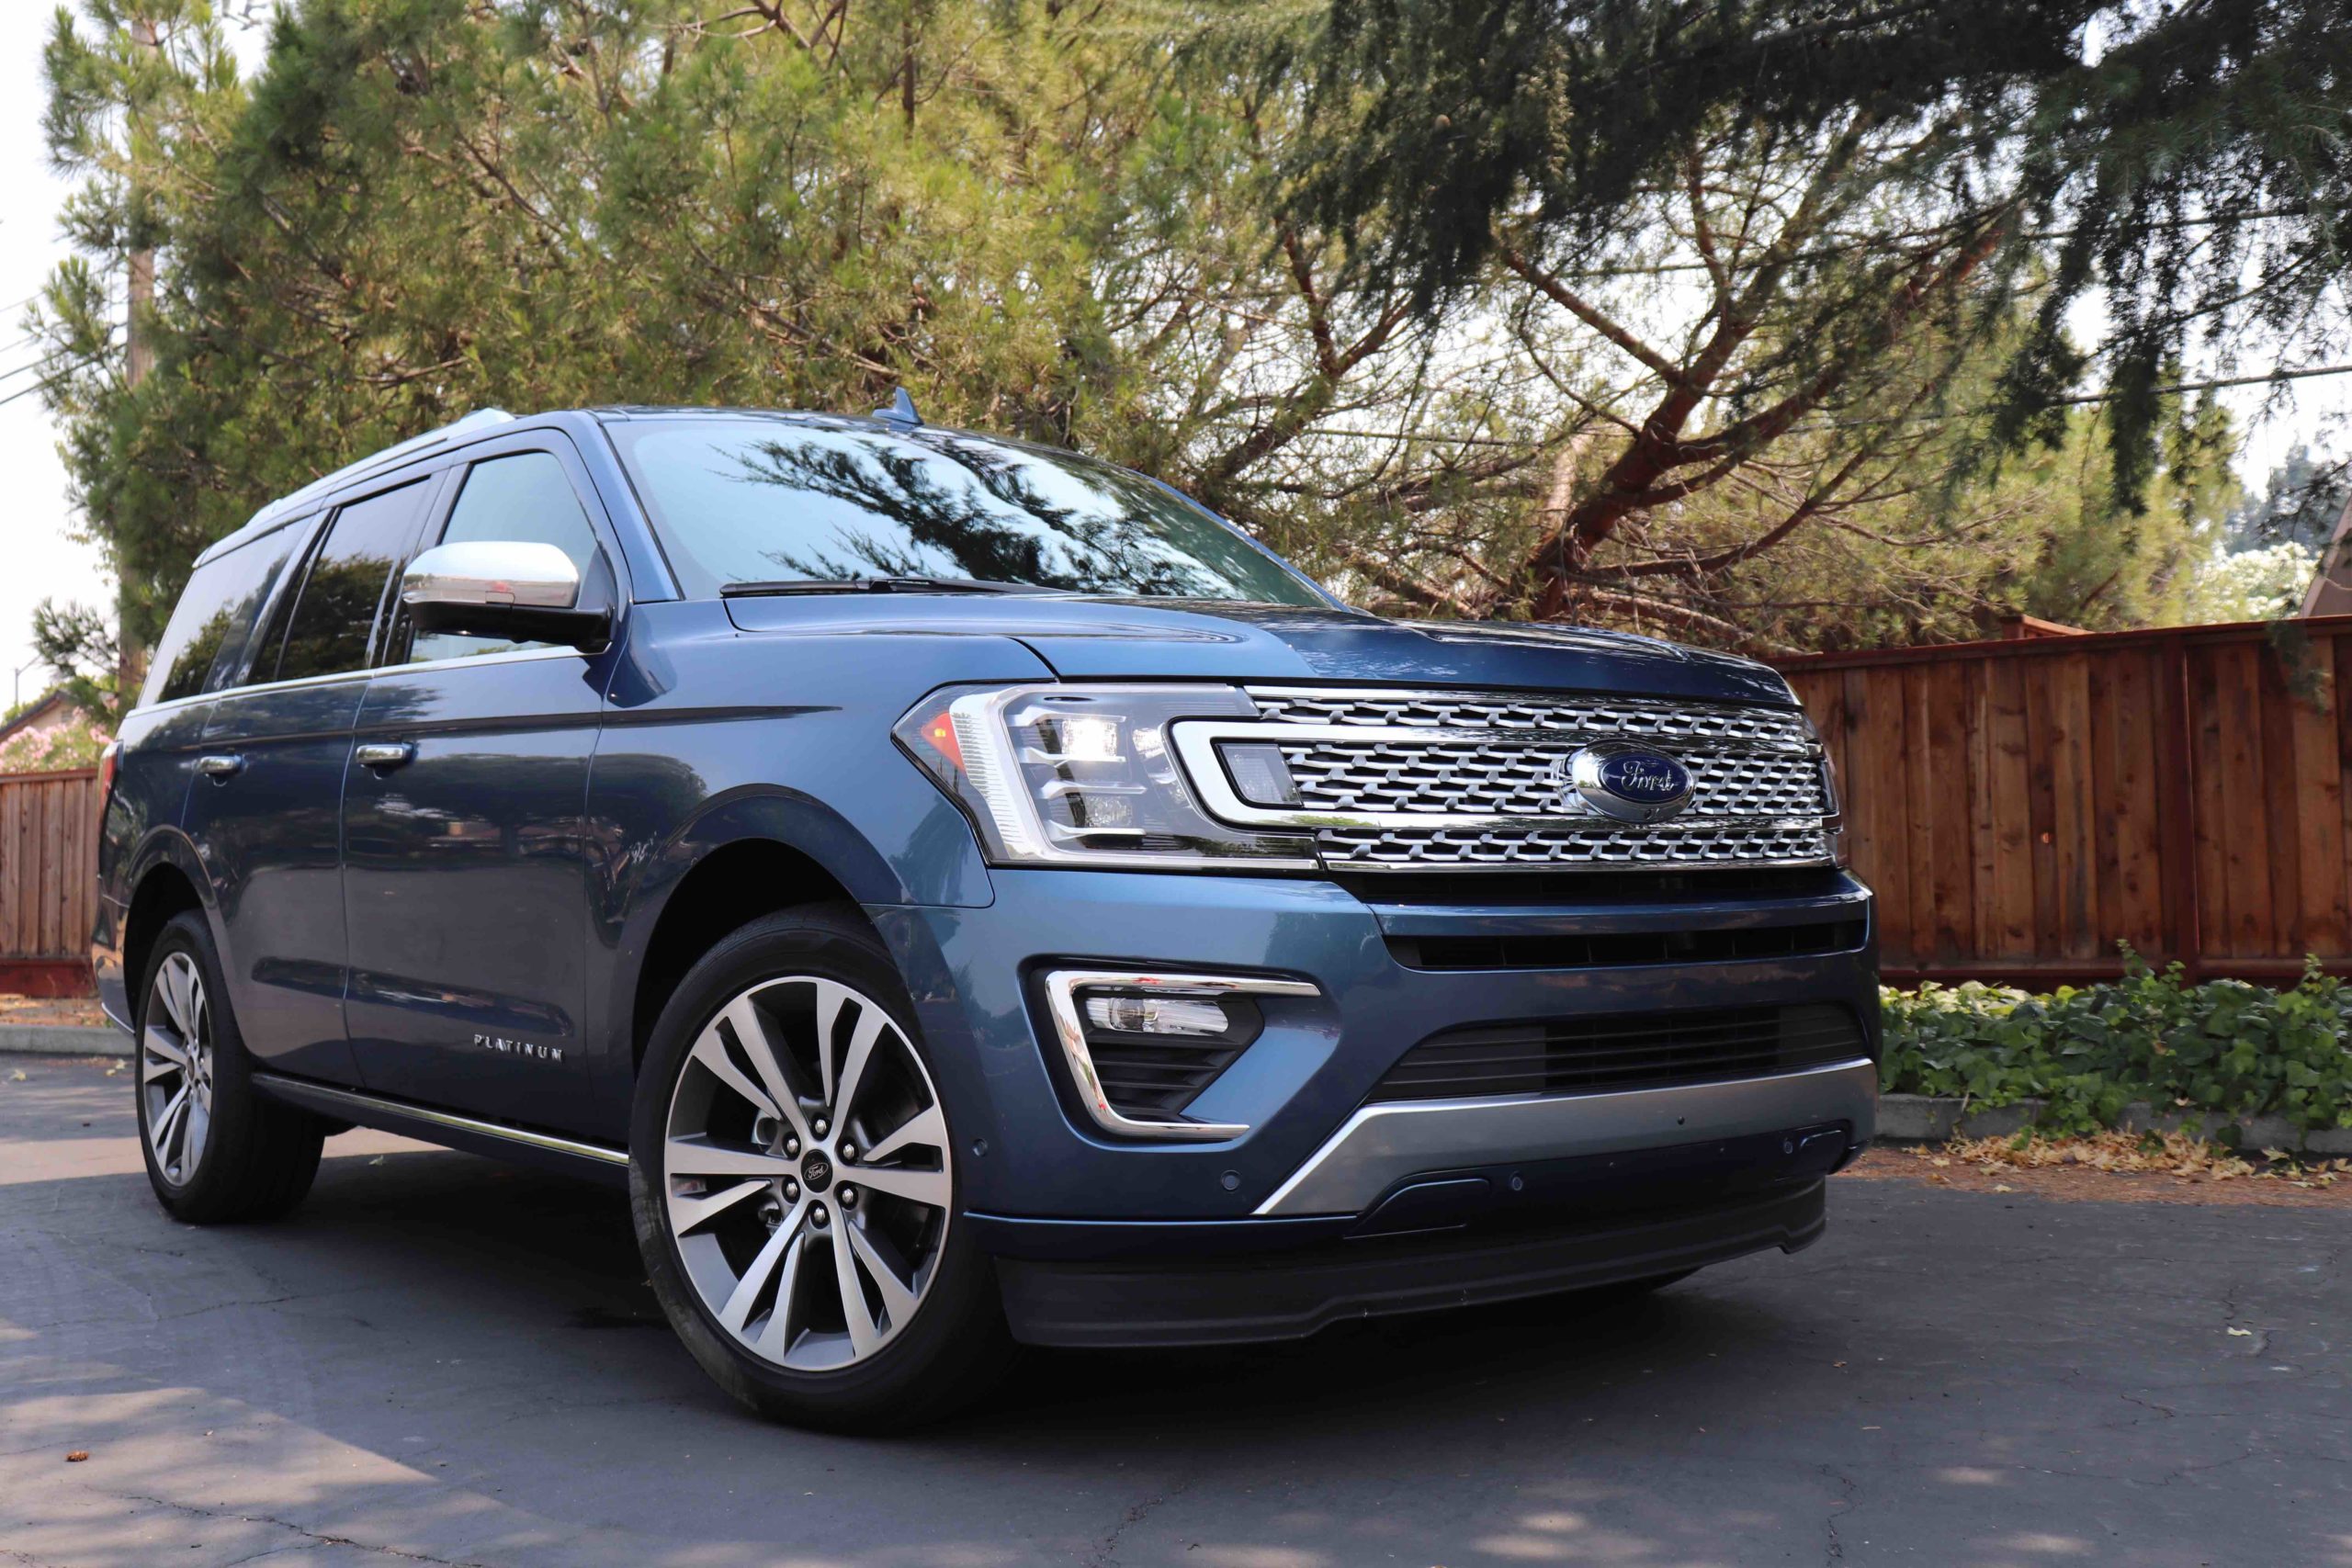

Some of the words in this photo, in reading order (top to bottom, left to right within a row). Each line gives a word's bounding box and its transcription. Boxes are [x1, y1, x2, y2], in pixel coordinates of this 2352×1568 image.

[1621, 760, 1676, 792] Ford
[473, 1033, 563, 1063] PLATINUM
[808, 1165, 824, 1179] Ford
